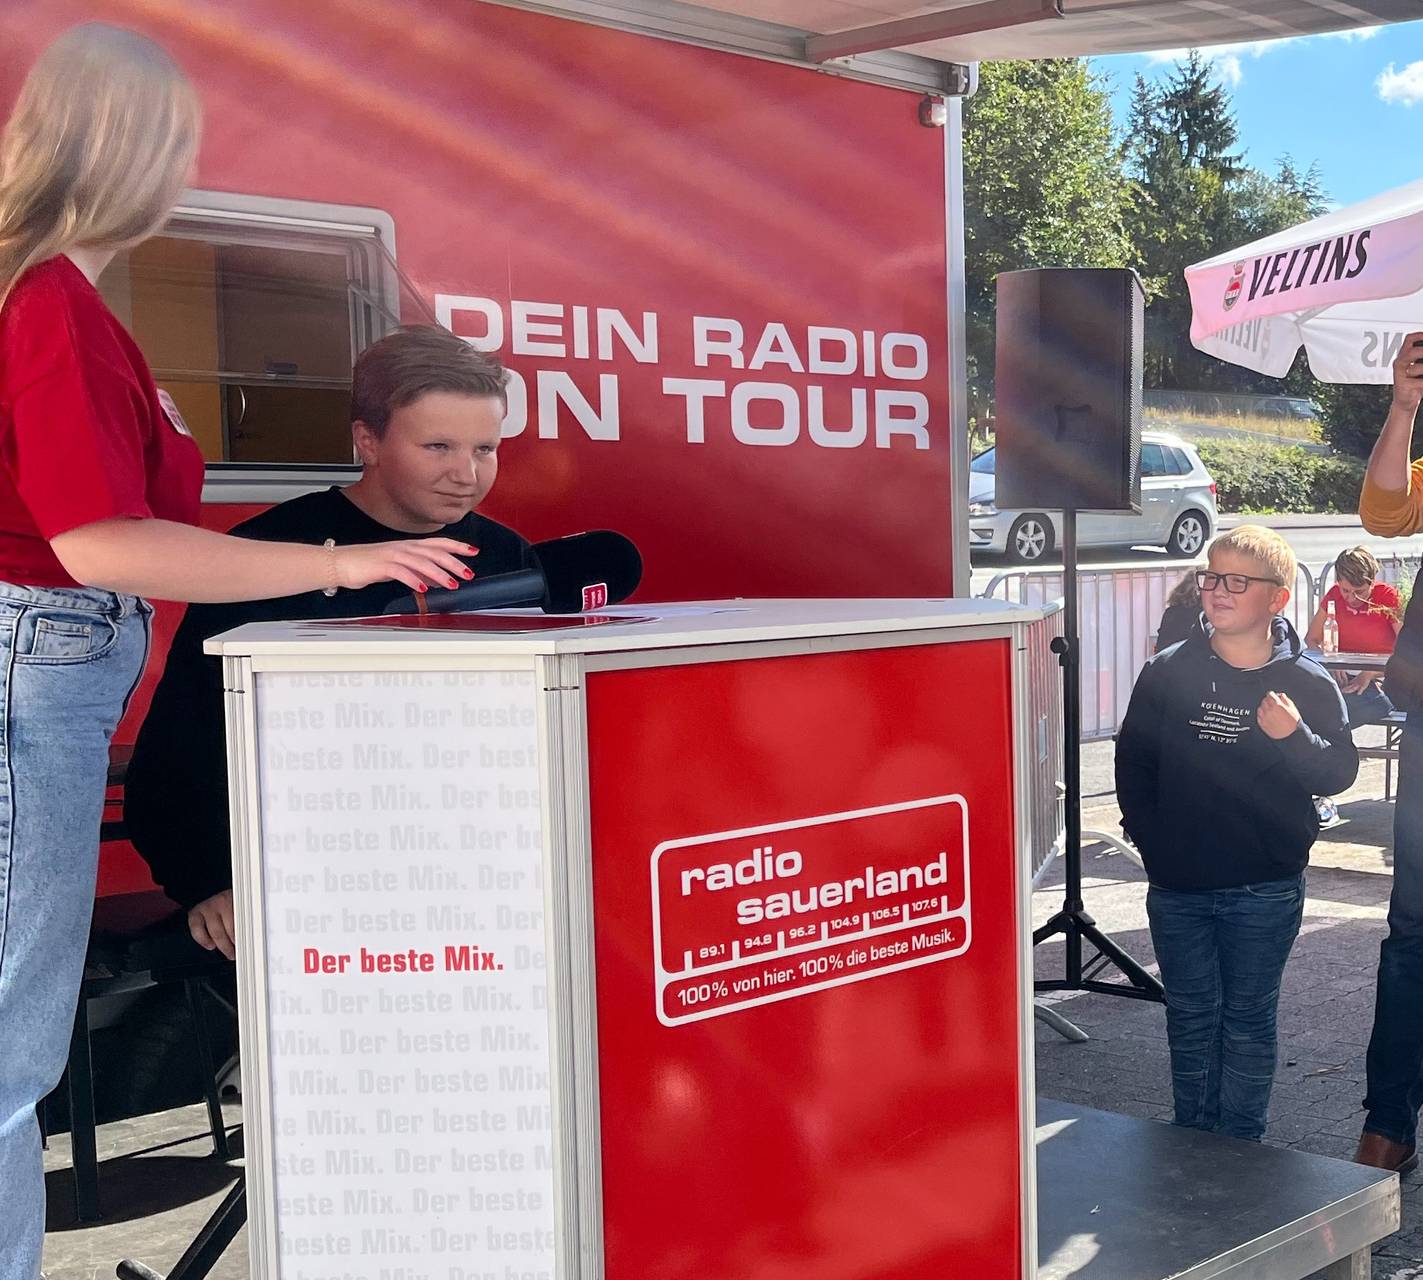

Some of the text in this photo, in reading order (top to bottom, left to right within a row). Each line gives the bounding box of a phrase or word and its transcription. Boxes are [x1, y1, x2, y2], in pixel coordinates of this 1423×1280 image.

[1248, 230, 1370, 302] VELTINS
[435, 293, 928, 380] DEIN RADIO
[662, 377, 930, 450] TOUR
[268, 705, 324, 729] este
[480, 743, 536, 768] best
[498, 783, 540, 809] bes
[266, 832, 296, 852] er
[681, 847, 802, 896] radio
[737, 853, 947, 925] sauerland
[700, 898, 938, 958] 89.1 94.8 96.2 104.9 106.5 107.6
[304, 945, 504, 973] Der beste Mix.
[678, 929, 955, 1006] 100% von hier. 100% die beste Musik.
[499, 1065, 548, 1091] Mix
[280, 1193, 333, 1216] este
